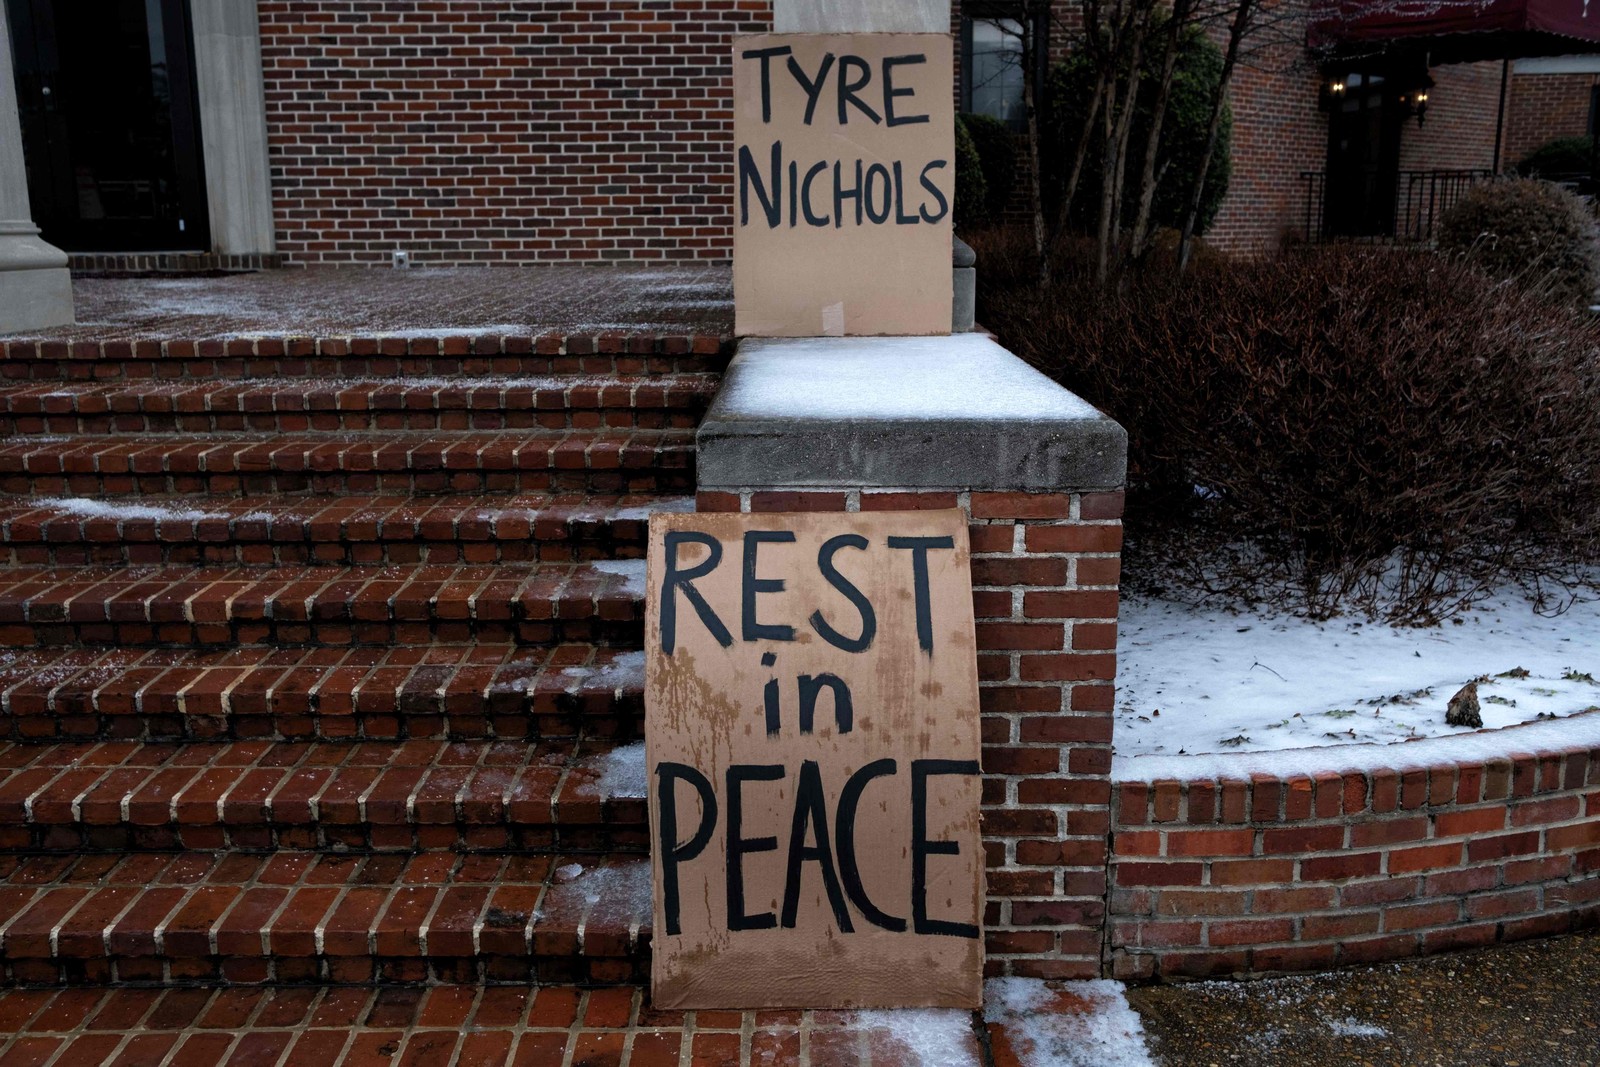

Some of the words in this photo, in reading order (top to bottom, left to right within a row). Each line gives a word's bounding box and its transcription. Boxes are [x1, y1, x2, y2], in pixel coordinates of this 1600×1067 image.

[742, 45, 930, 127] TYRE
[738, 140, 949, 229] NICHOLS
[659, 531, 954, 658] REST
[761, 652, 853, 736] in
[655, 758, 982, 938] PEACE
